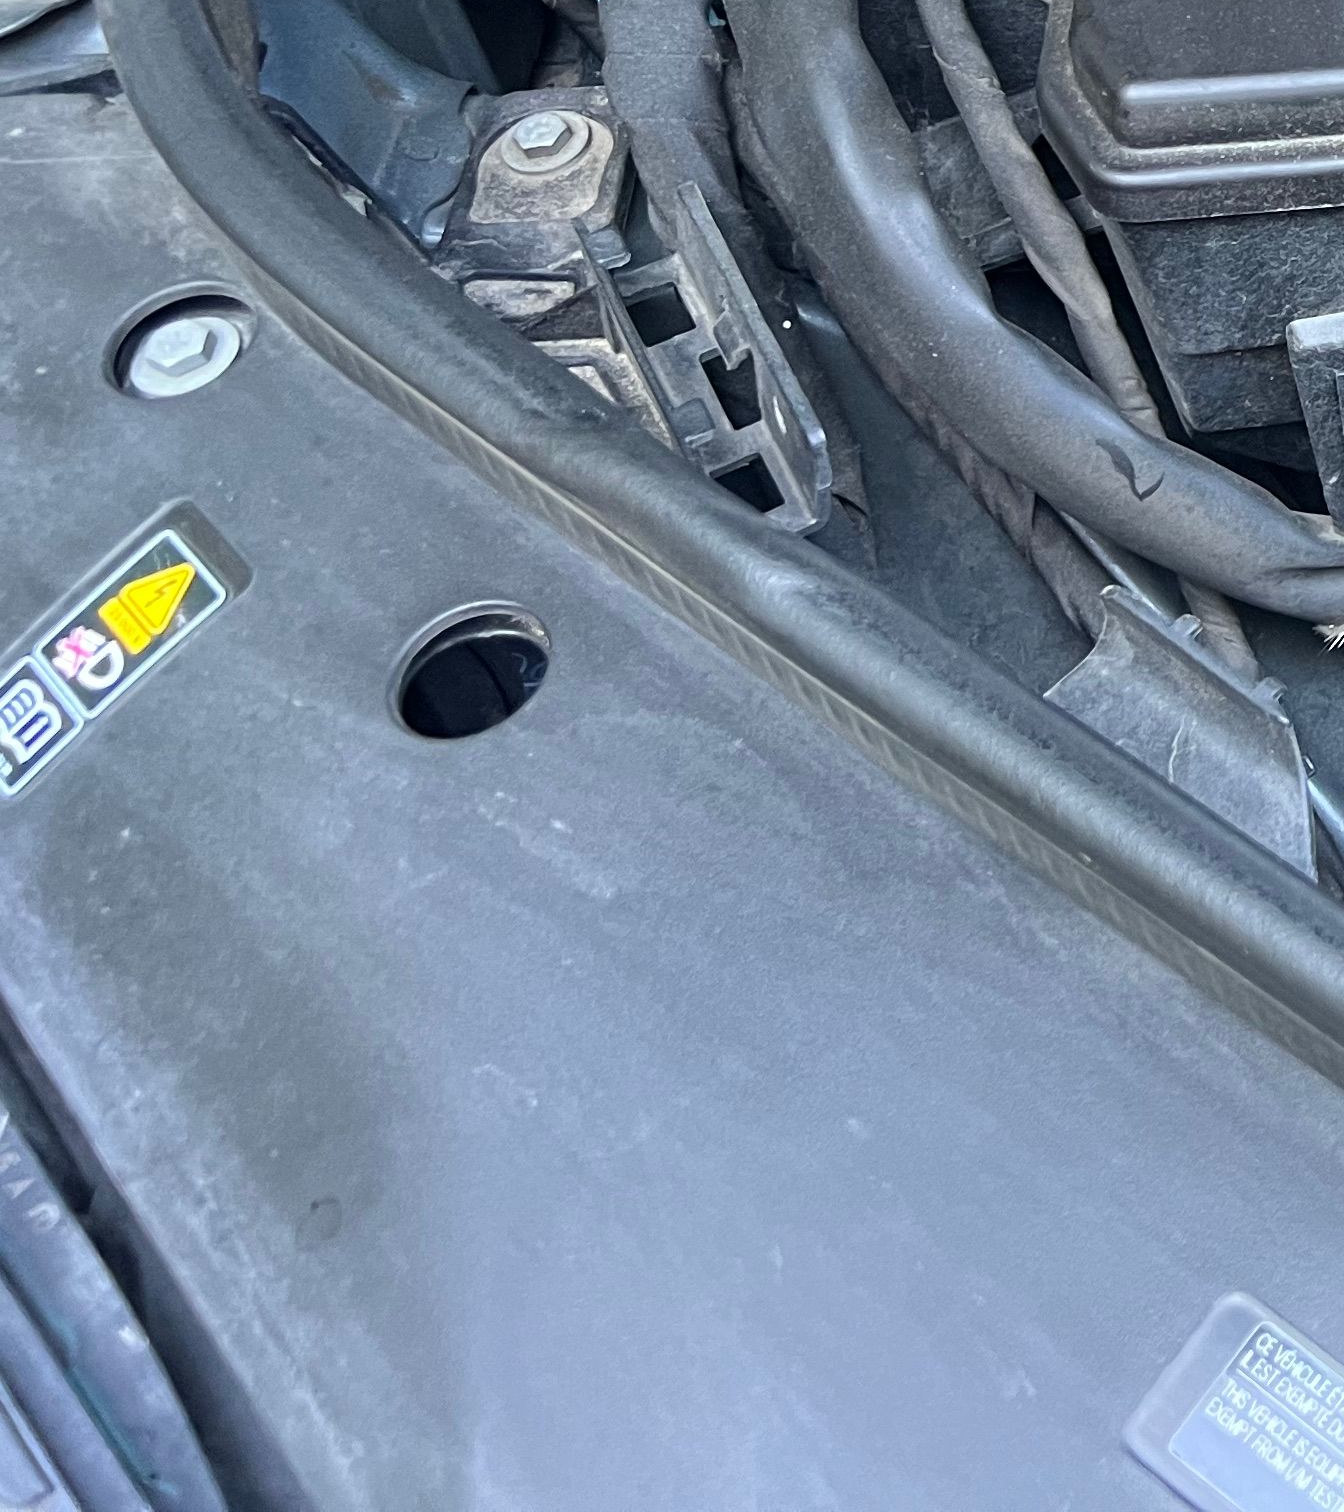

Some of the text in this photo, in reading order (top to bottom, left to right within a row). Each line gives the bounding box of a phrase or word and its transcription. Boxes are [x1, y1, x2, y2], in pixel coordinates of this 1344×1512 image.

[1251, 1358, 1281, 1386] EST
[1256, 1332, 1279, 1357] CE
[1274, 1344, 1332, 1399] VÉHICULE
[1205, 1396, 1257, 1443] EXEMPT
[1251, 1434, 1291, 1473] FROM
[1221, 1377, 1251, 1409] THIS
[1248, 1399, 1298, 1448] VEHICLE
[1292, 1436, 1310, 1457] IS
